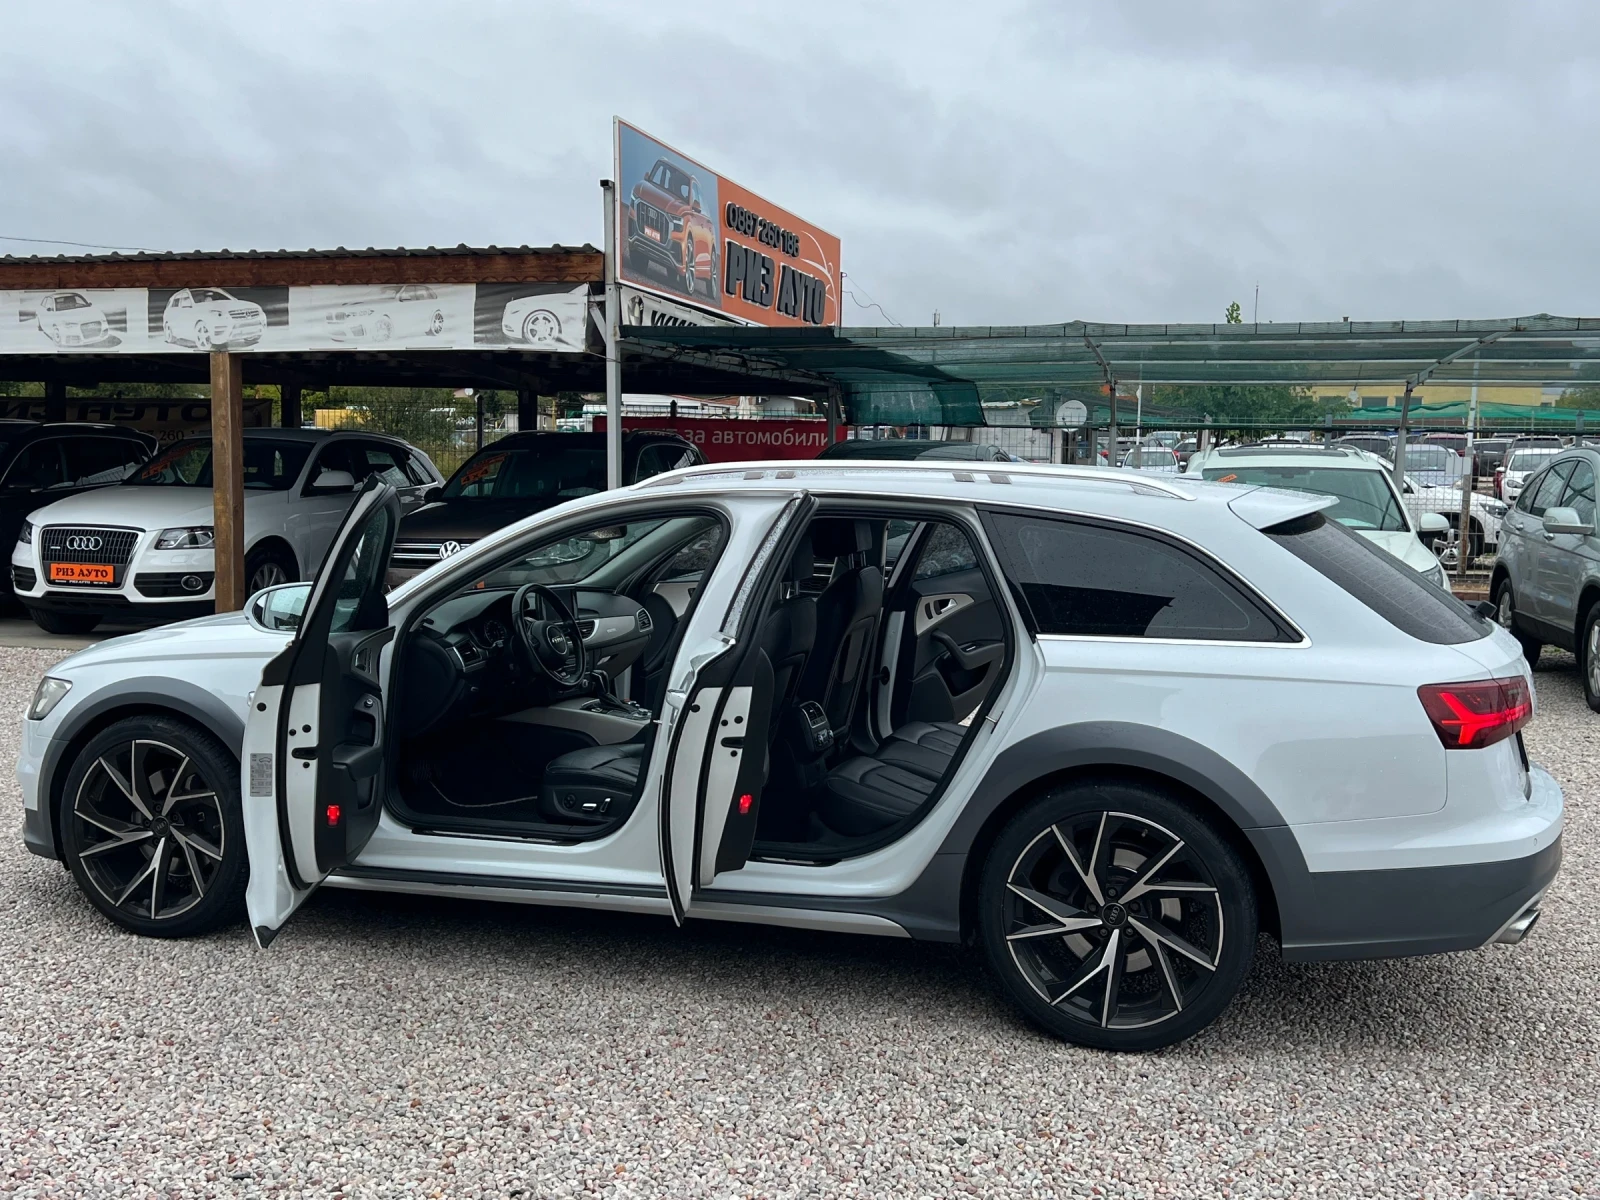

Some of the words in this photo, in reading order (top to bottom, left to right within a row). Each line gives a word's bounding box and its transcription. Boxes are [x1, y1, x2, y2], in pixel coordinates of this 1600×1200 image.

[725, 201, 759, 238] 0887
[758, 216, 781, 250] 260
[781, 228, 800, 258] 186
[725, 237, 775, 309] РИЗ
[776, 261, 826, 326] АУТО
[687, 429, 705, 443] за
[711, 428, 828, 447] автомобили
[77, 568, 109, 578] АУТО
